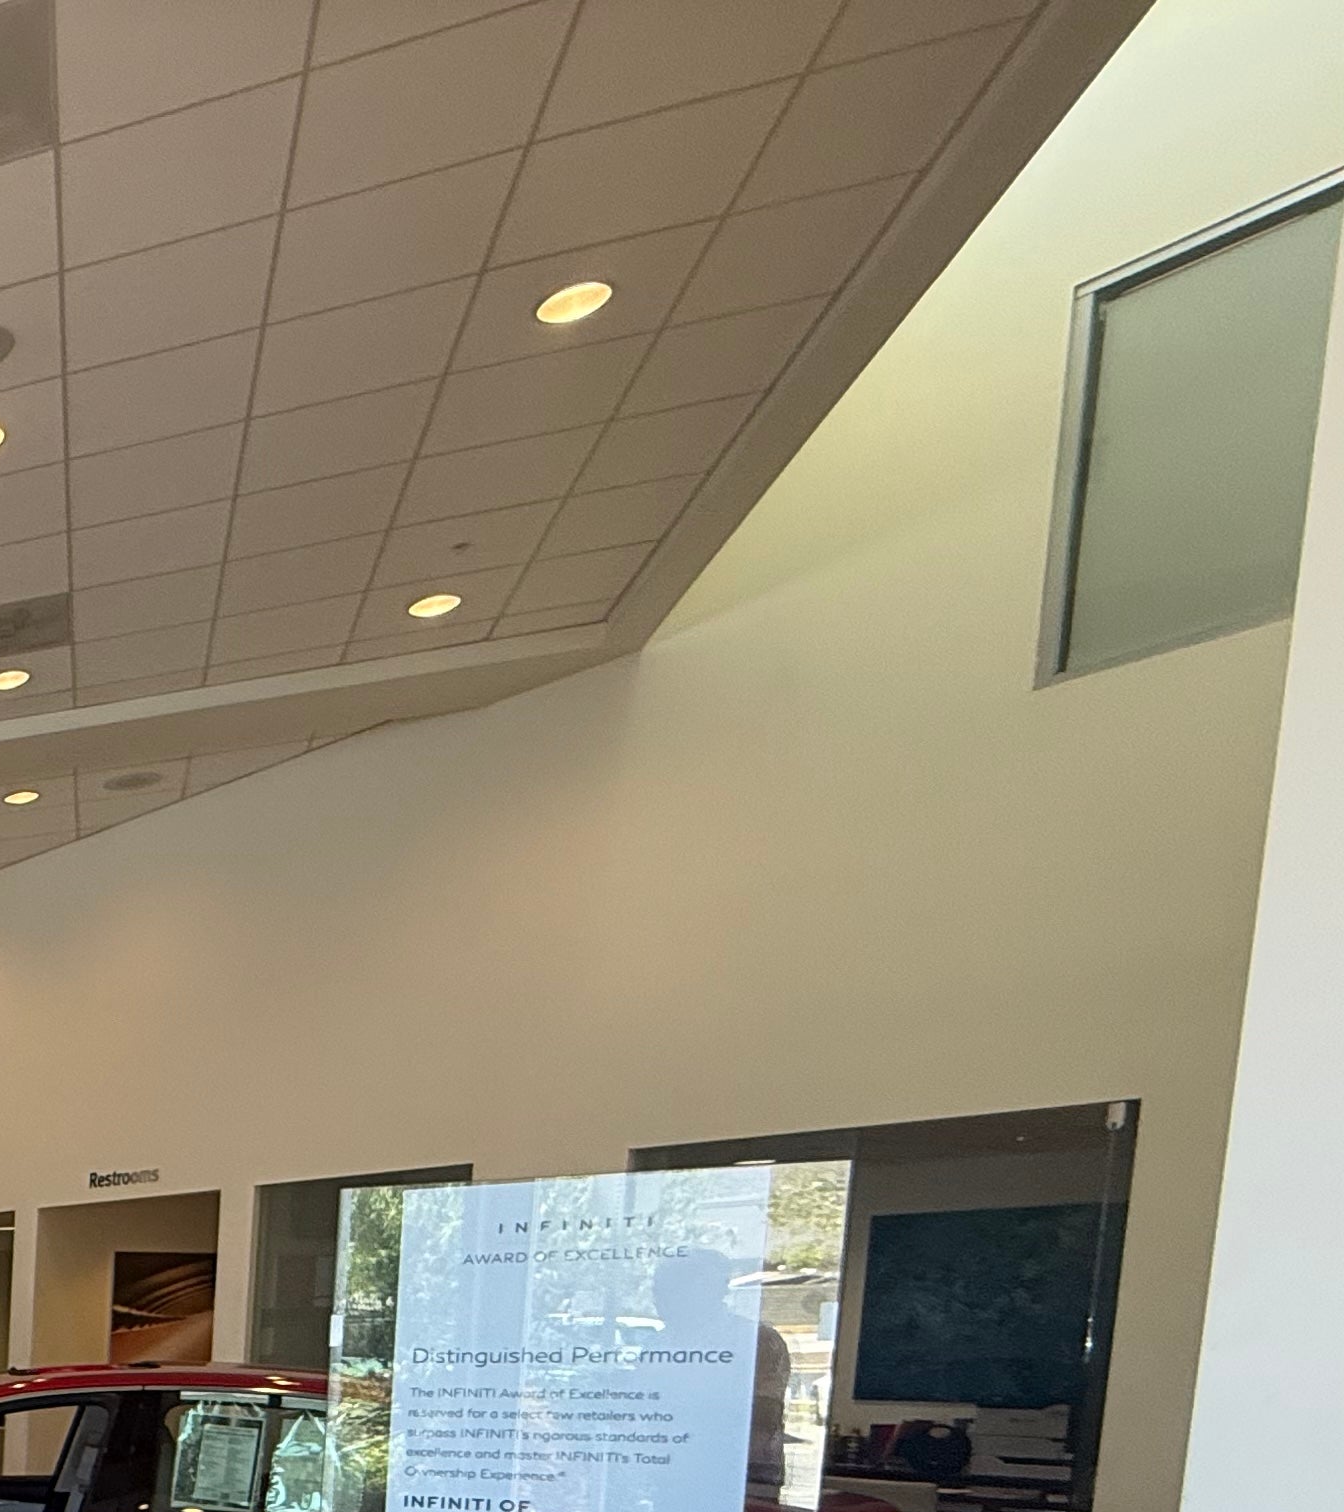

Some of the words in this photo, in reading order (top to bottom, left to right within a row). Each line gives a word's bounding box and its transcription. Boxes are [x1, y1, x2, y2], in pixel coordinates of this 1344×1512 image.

[89, 1168, 159, 1189] Restrooms
[498, 1216, 653, 1234] INFINITI
[463, 1252, 528, 1266] AWARD
[534, 1250, 557, 1262] OF
[564, 1246, 689, 1261] EXCELLENCE
[412, 1347, 562, 1367] Distinguished
[571, 1346, 733, 1364] Performance
[410, 1387, 434, 1398] The
[438, 1387, 496, 1398] INFINITI
[499, 1388, 546, 1399] Award
[550, 1389, 564, 1399] of
[569, 1389, 644, 1400] Excellence
[648, 1391, 660, 1400] is
[408, 1408, 463, 1419] reserved
[468, 1408, 487, 1419] for
[490, 1410, 498, 1419] a
[502, 1409, 541, 1420] select
[578, 1410, 635, 1421] retailers
[639, 1412, 673, 1422] who
[533, 1431, 592, 1442] rigorous
[595, 1431, 668, 1443] standards
[672, 1433, 689, 1443] of
[406, 1448, 471, 1458] excellence
[474, 1449, 500, 1459] and
[504, 1450, 551, 1461] master
[633, 1453, 671, 1464] Total
[403, 1495, 492, 1511] INFINITI
[499, 1499, 531, 1512] OF
